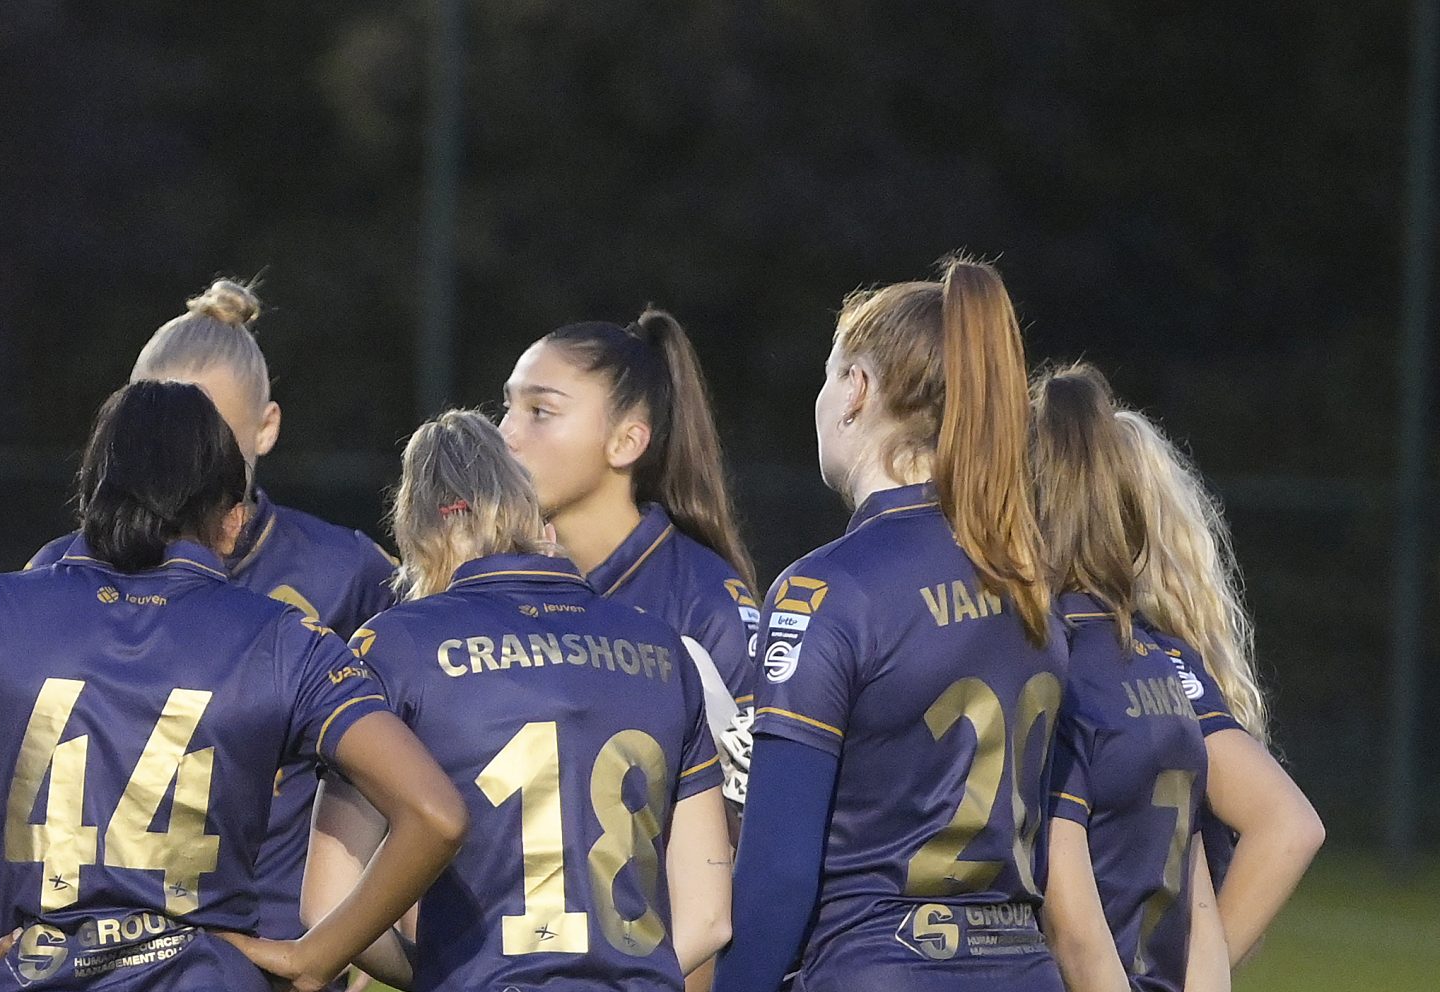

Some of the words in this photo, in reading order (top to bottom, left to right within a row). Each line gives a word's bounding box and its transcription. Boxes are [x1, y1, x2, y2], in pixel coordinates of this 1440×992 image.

[125, 593, 168, 606] leuven
[543, 602, 586, 614] leuven
[437, 632, 672, 683] CRANSHOFF
[5, 678, 220, 916] 44
[474, 721, 668, 957] 18
[77, 912, 177, 948] GROU
